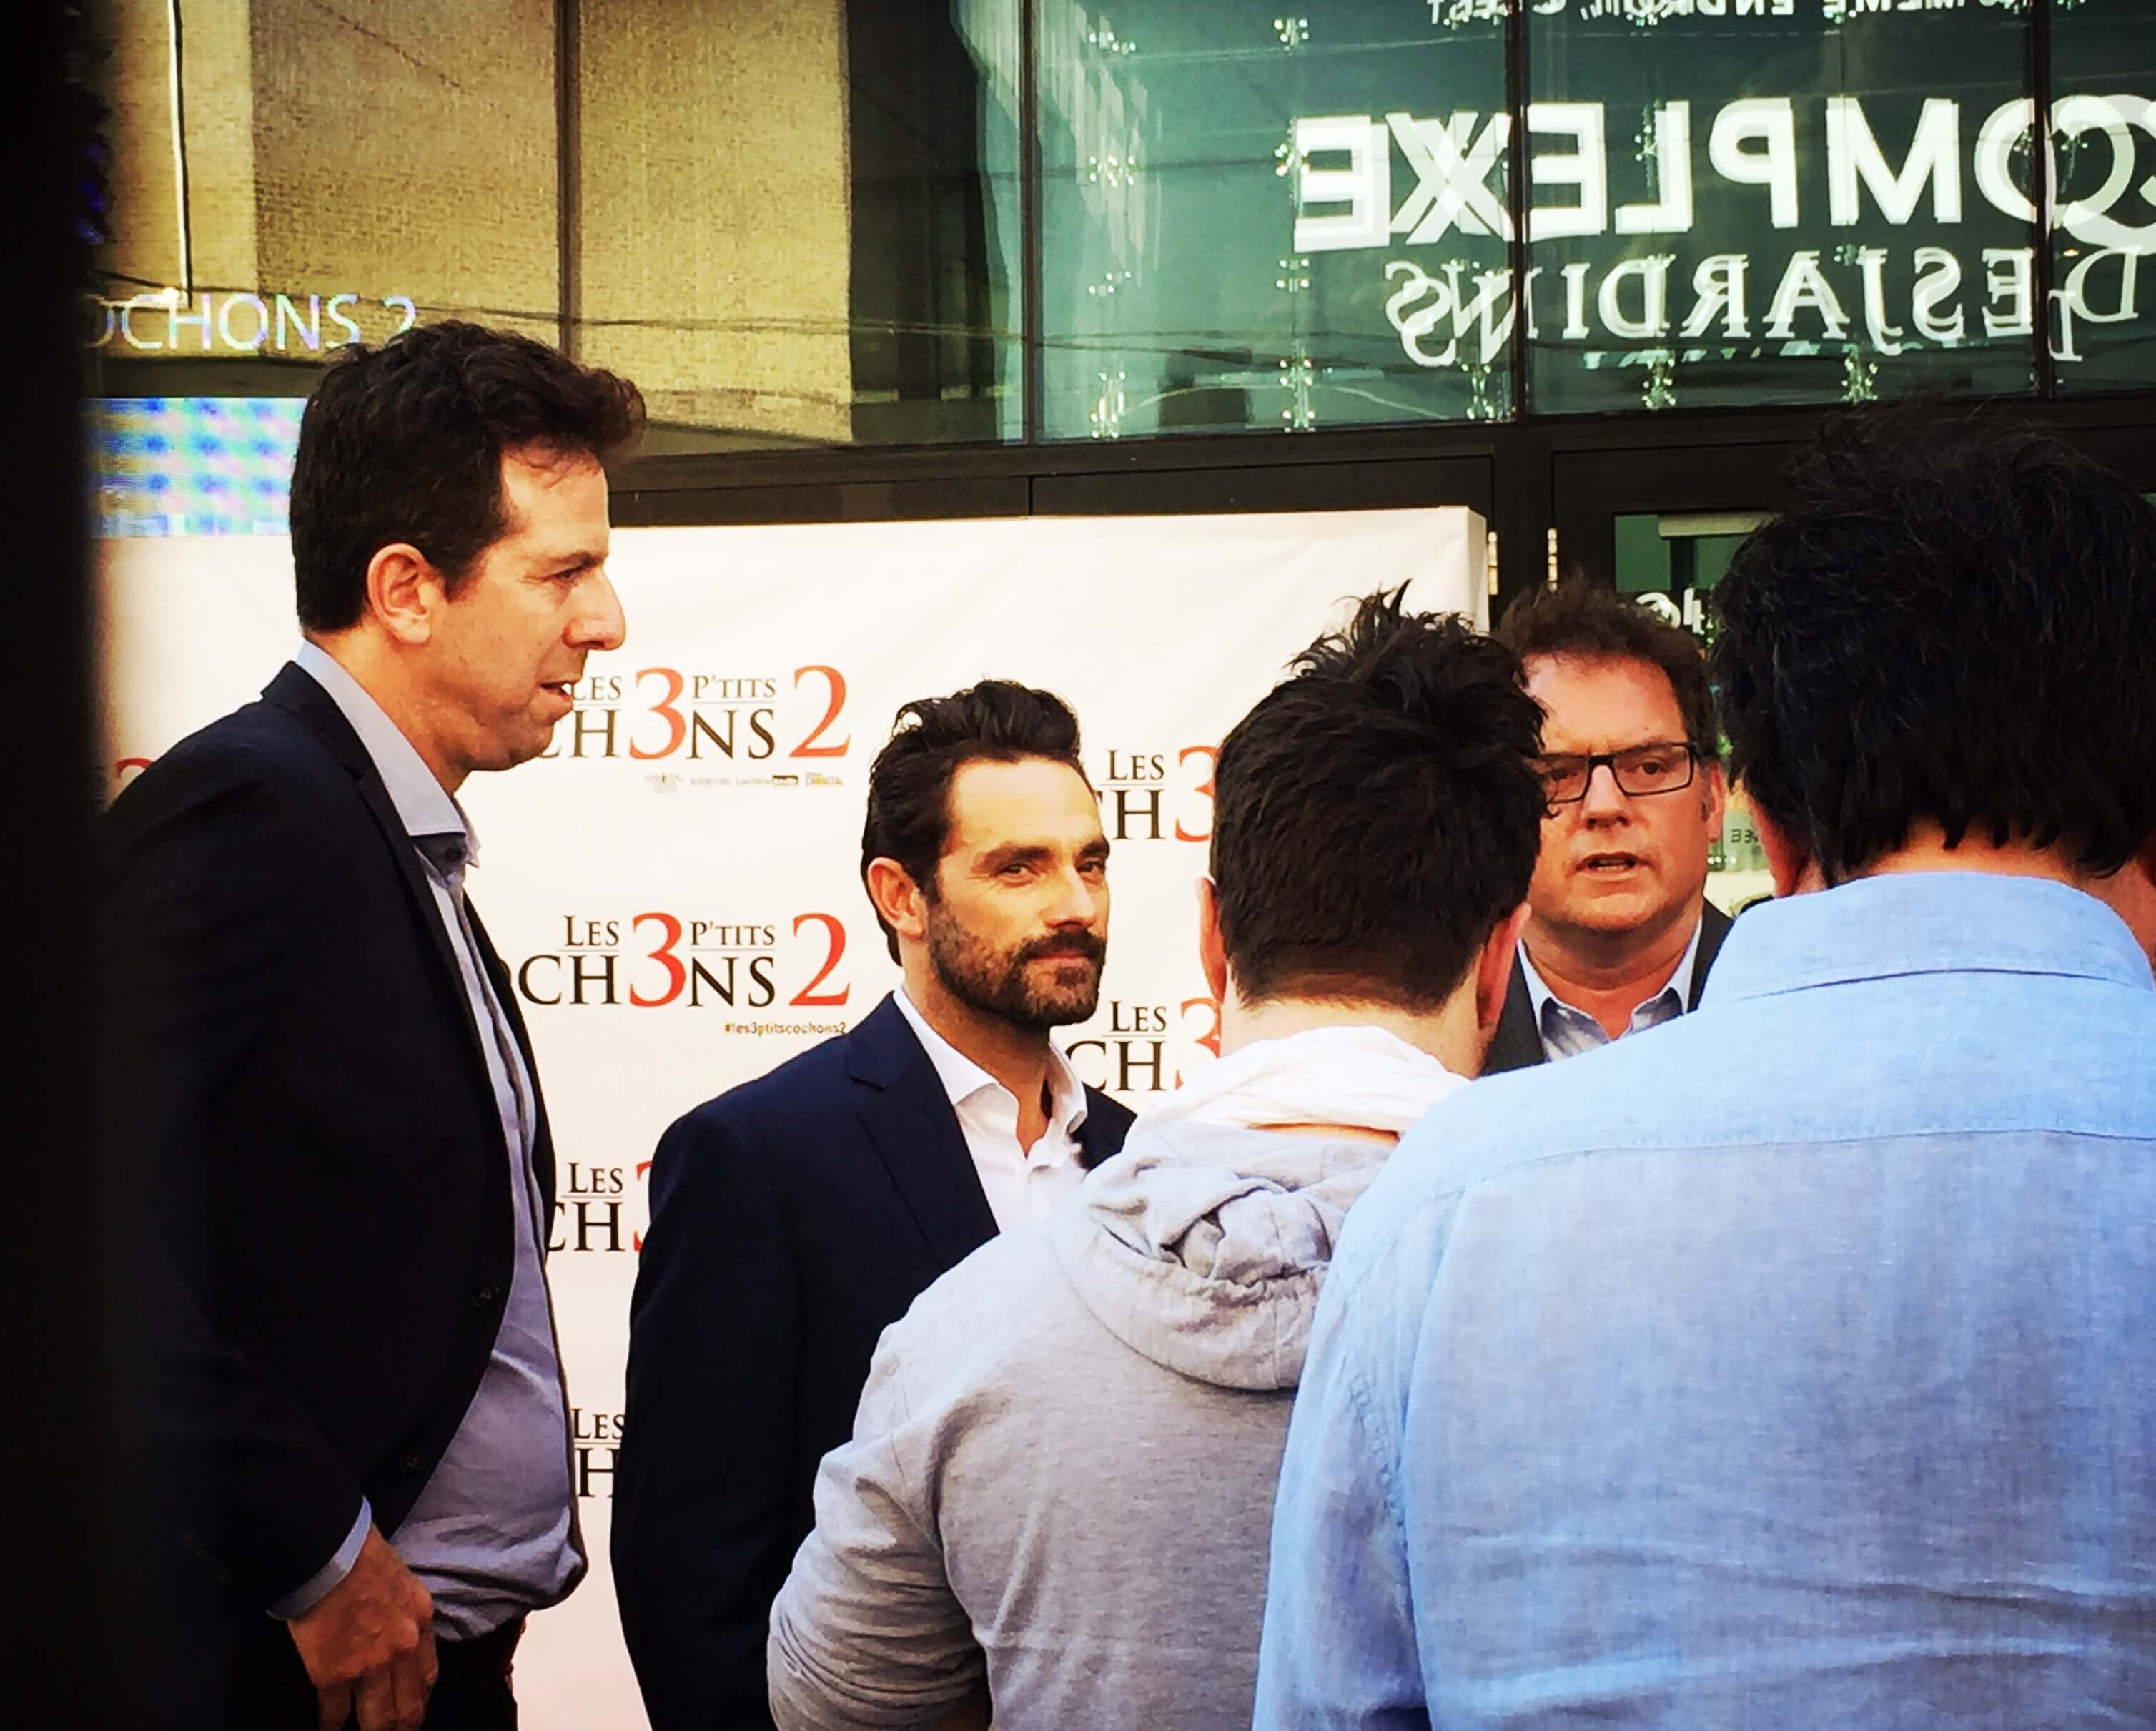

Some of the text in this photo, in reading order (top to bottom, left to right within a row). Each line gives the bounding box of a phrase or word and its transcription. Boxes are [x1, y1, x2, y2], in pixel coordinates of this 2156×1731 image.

[629, 667, 686, 760] 3
[789, 666, 851, 759] 2
[1107, 750, 1164, 781] LES
[563, 914, 620, 947] LES
[629, 912, 686, 1007] 3
[789, 913, 851, 1007] 2
[1110, 1000, 1167, 1032] LES
[568, 1161, 623, 1194] LES
